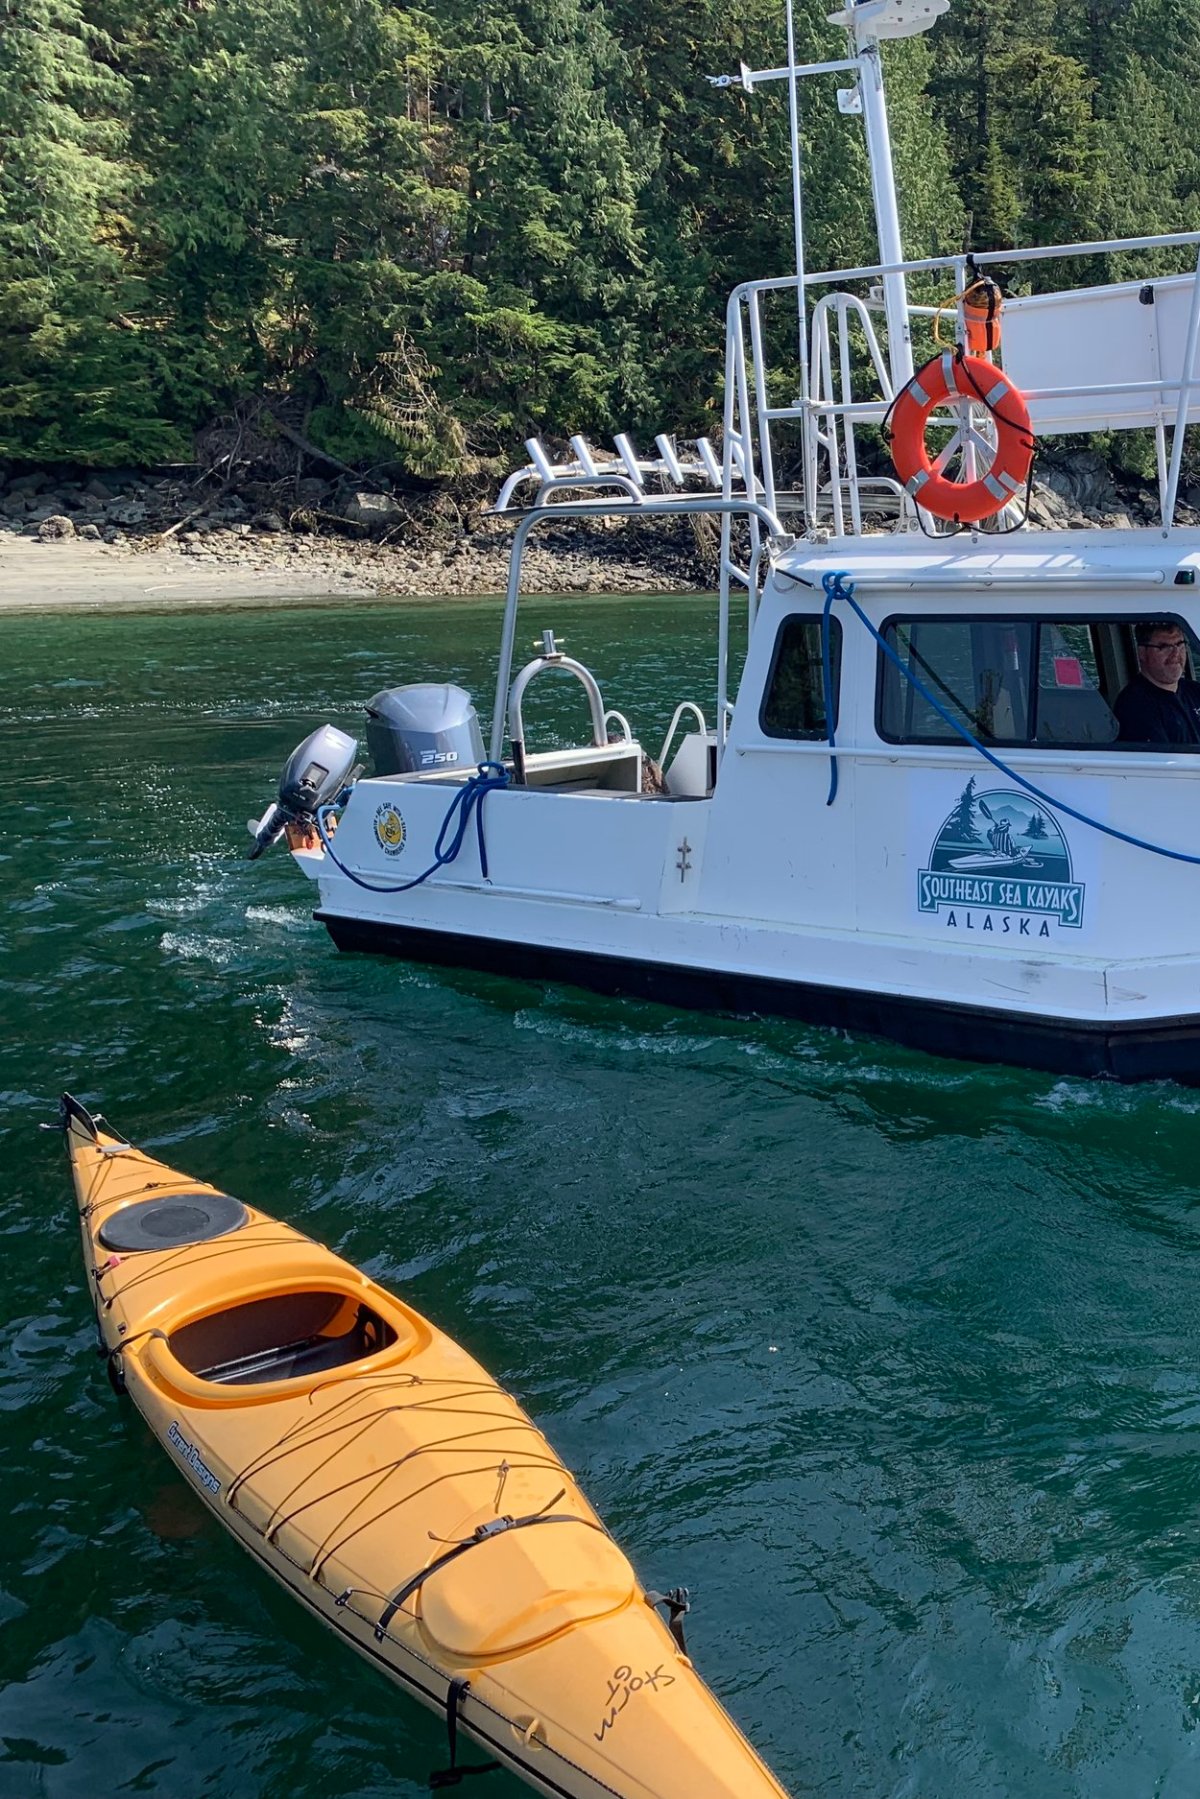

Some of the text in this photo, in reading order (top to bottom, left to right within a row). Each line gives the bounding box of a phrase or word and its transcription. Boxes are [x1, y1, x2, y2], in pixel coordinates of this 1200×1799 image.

[422, 751, 458, 764] 250
[922, 874, 1079, 922] SOUTHEAST SEA KAYAKS
[946, 910, 1050, 938] ALASKA
[167, 1420, 222, 1495] Current Designs
